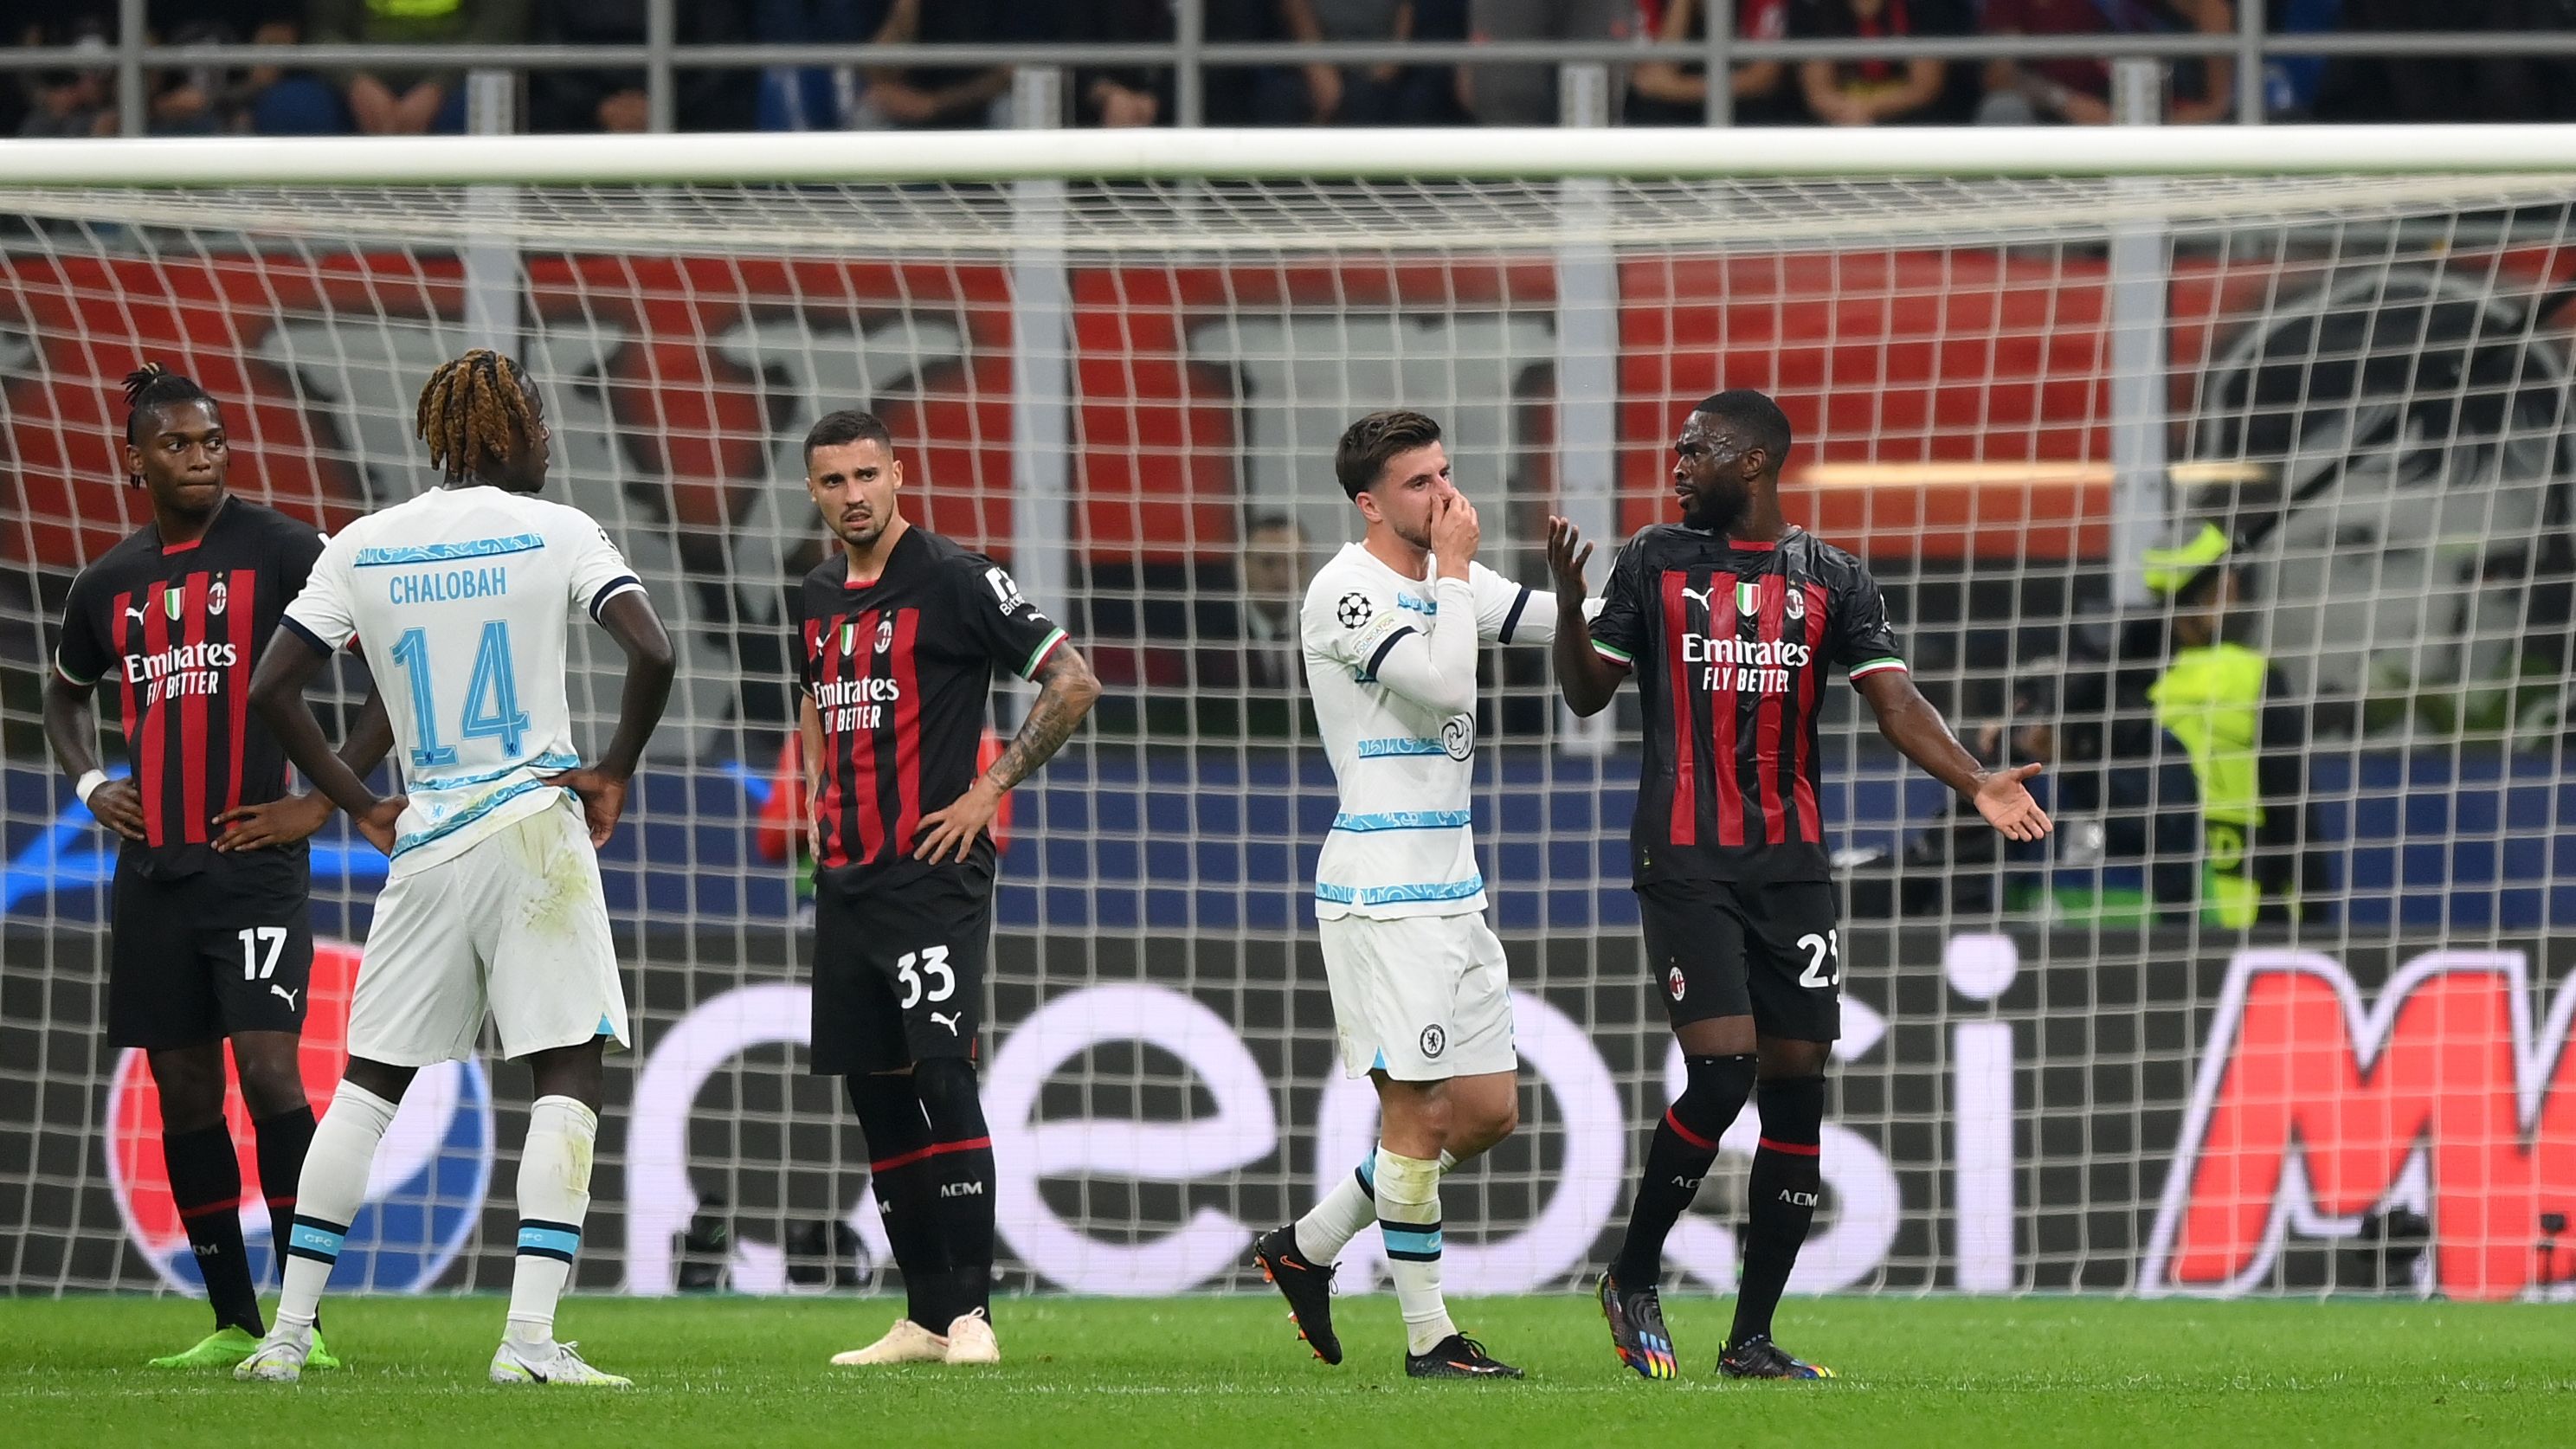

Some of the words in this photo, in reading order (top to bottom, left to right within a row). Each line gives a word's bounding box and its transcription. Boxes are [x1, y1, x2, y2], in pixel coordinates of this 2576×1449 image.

[390, 567, 506, 604] CHALOBAH
[124, 639, 237, 683] Emirates
[1681, 633, 1812, 667] Emirates
[165, 671, 219, 699] BETTER
[389, 619, 532, 769] 14
[812, 675, 900, 709] Emirates
[1702, 667, 1732, 691] FLY
[1736, 667, 1790, 693] BETTER
[836, 705, 882, 732] BETTER
[238, 926, 287, 981] 17
[897, 944, 956, 1009] 33
[625, 936, 2013, 1291] pepsi
[2136, 950, 2576, 1301] M
[940, 1181, 983, 1199] ACM
[1671, 1175, 1704, 1189] AC
[1778, 1188, 1819, 1208] ACM
[304, 1233, 332, 1247] CFC
